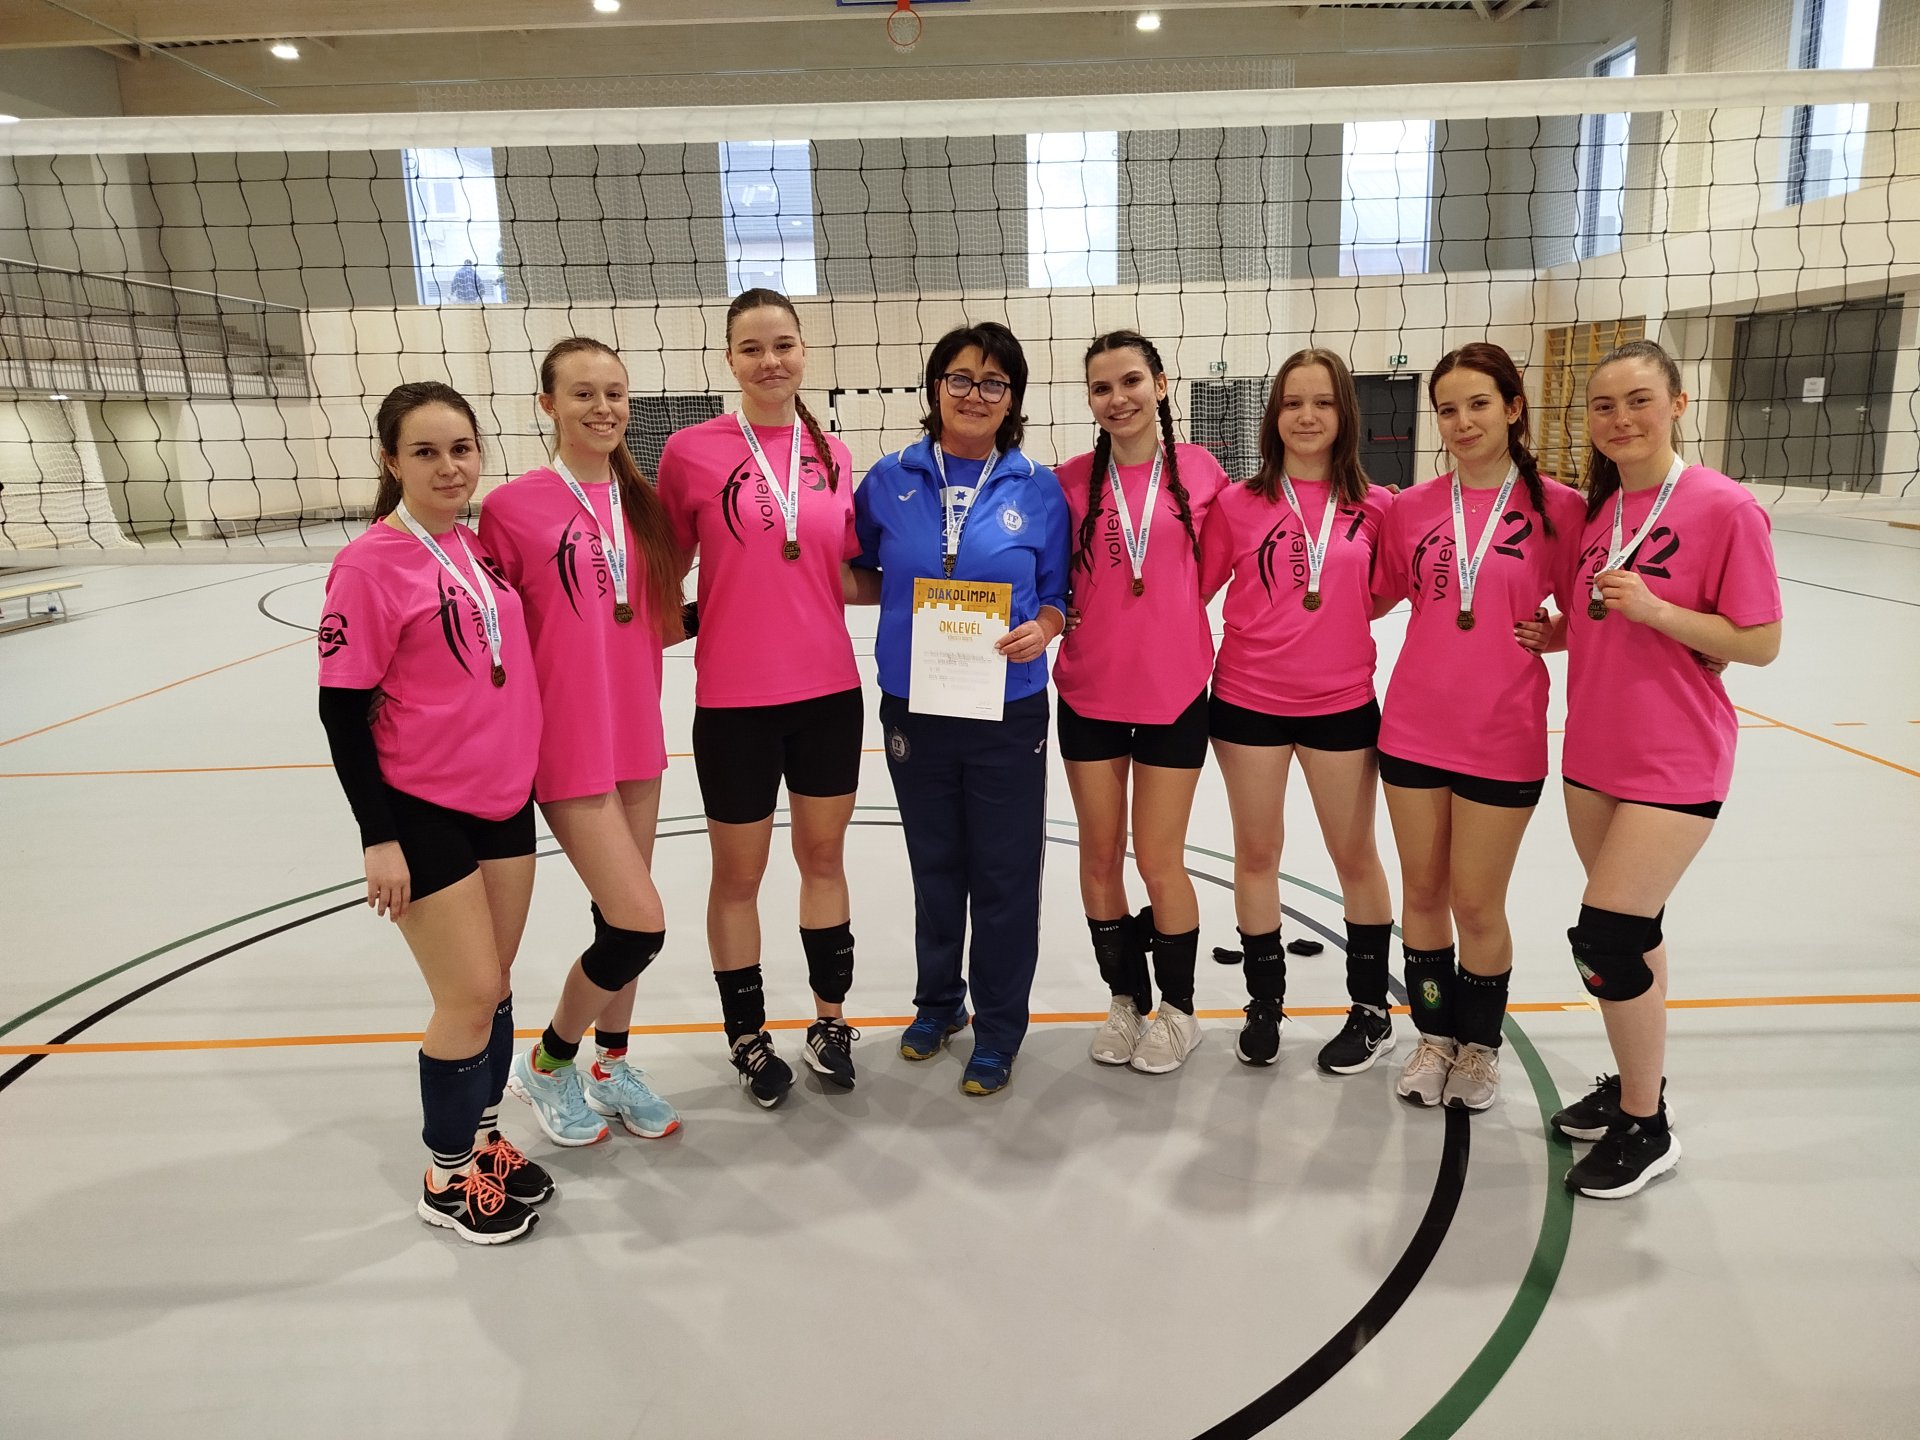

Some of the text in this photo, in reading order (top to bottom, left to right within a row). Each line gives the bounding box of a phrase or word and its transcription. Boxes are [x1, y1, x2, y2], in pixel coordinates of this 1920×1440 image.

[753, 472, 776, 532] volley
[1006, 512, 1019, 523] TF
[1339, 508, 1366, 542] 7
[1104, 508, 1122, 568] volley
[1289, 530, 1306, 590] volley
[1492, 510, 1533, 561] 2
[584, 531, 609, 598] volley
[1432, 535, 1457, 601] volley
[456, 585, 488, 653] volley
[927, 587, 997, 604] DIAKOLIMPIA
[939, 620, 983, 635] OKLEVÉL
[1257, 954, 1278, 962] ALLSIX
